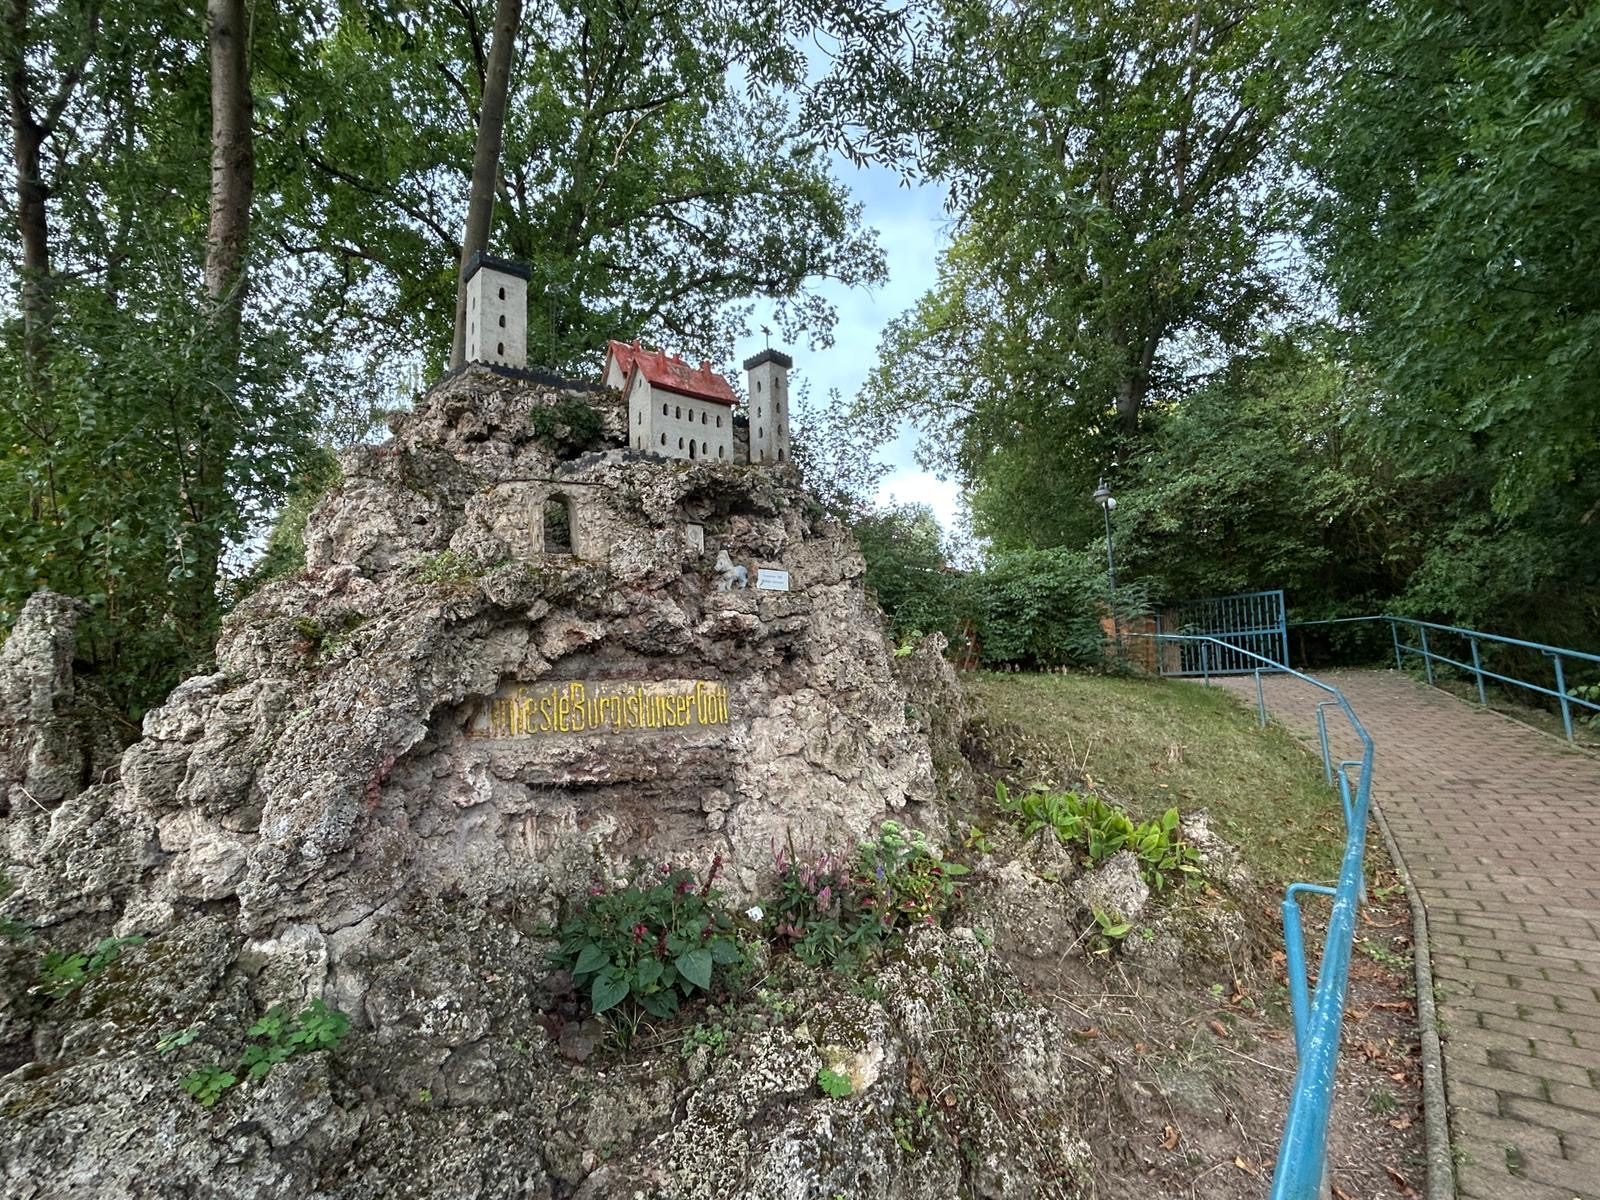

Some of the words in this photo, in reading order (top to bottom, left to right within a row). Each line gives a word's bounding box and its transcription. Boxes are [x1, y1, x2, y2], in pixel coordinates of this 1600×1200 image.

[570, 682, 621, 734] Burg
[645, 693, 695, 729] unser
[696, 681, 729, 725] Gott
